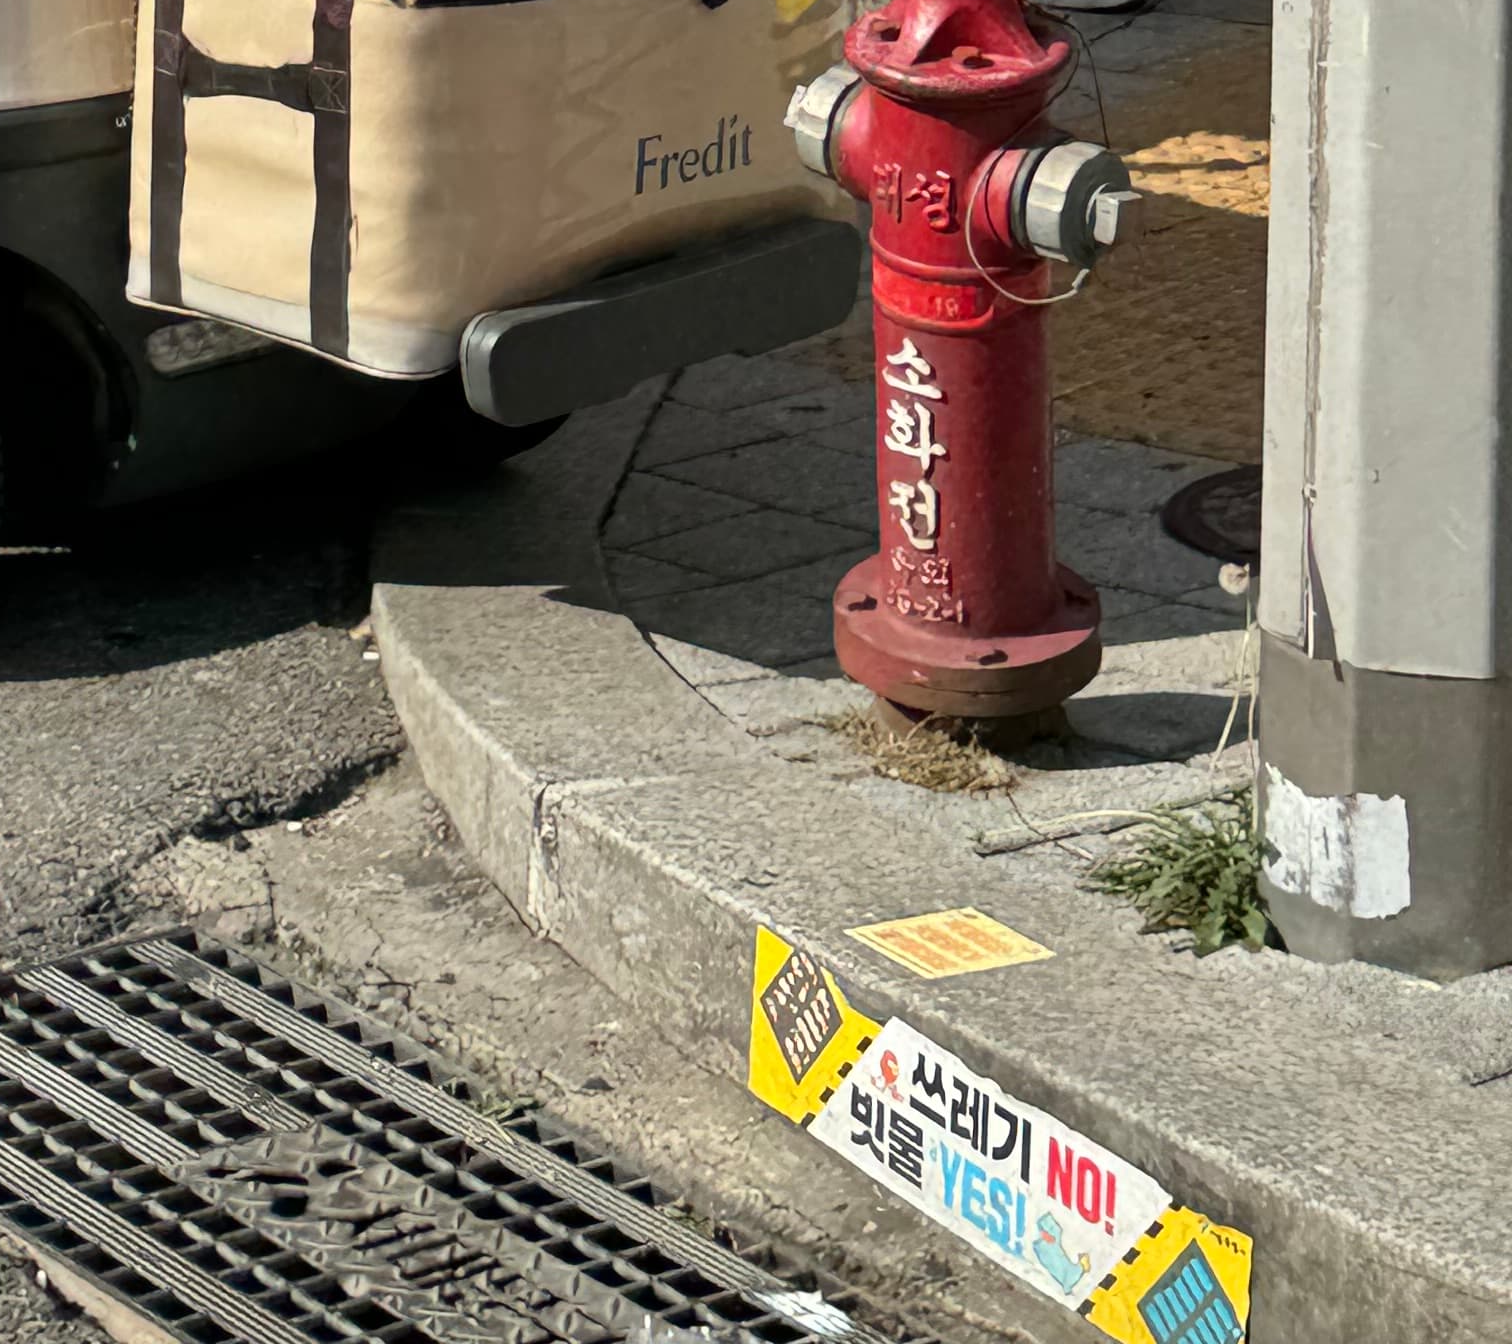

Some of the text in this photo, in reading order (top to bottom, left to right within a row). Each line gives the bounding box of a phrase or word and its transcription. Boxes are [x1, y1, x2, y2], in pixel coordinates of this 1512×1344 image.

[634, 113, 753, 196] Fredit
[882, 336, 947, 551] 소화전
[849, 1082, 1027, 1256] 빗물 YES!
[909, 1052, 1117, 1238] 쓰레기 NO!
